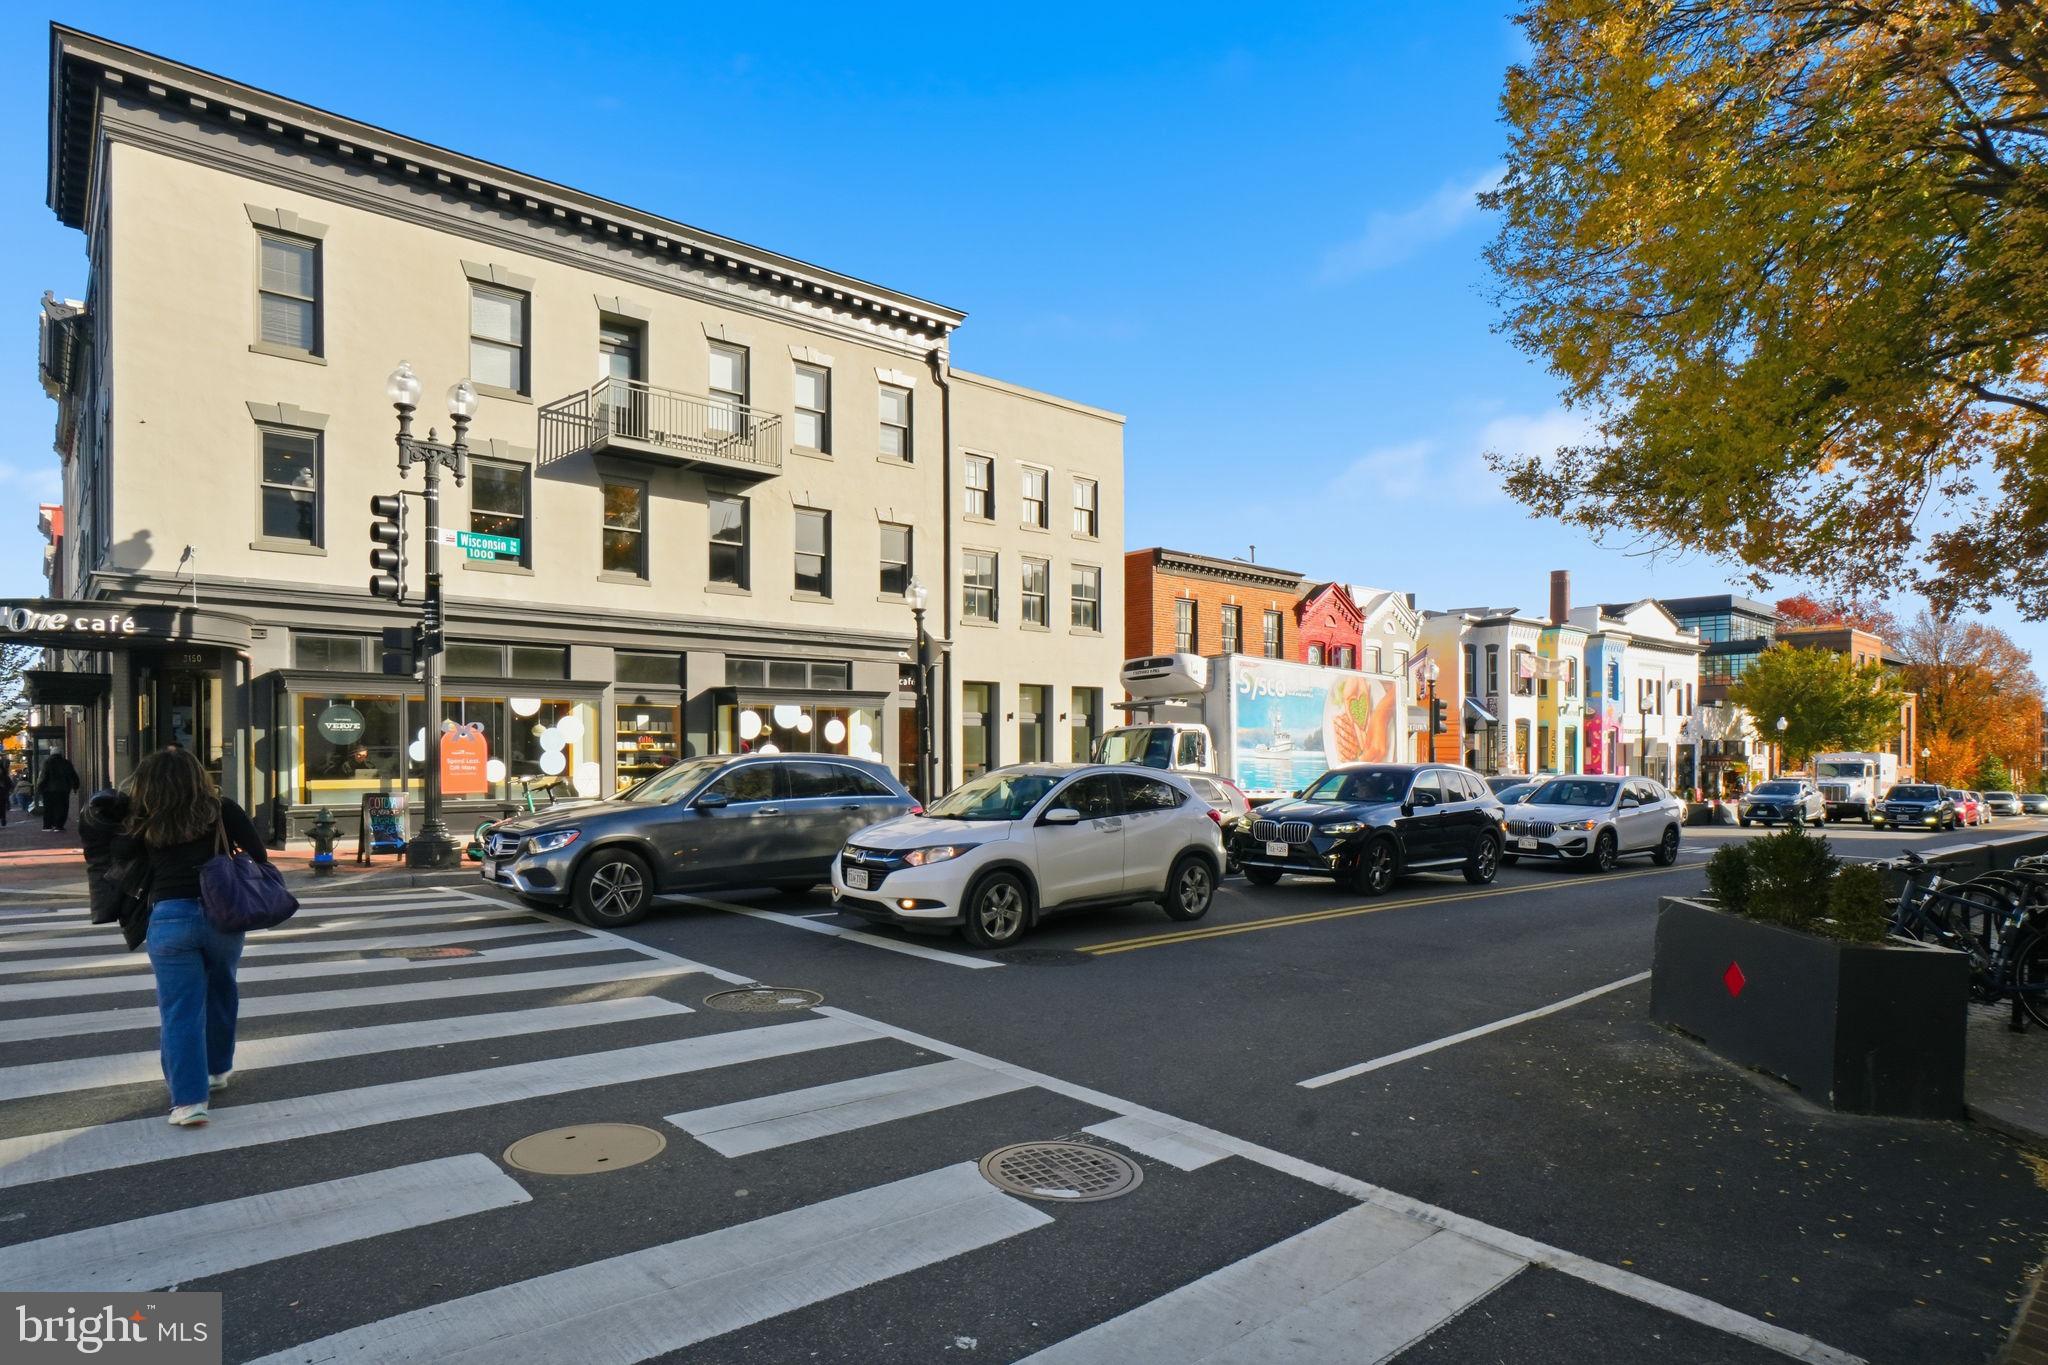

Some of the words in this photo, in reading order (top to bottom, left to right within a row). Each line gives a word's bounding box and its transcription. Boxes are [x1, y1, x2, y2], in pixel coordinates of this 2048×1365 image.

[460, 533, 507, 552] Wisconsin
[469, 548, 495, 559] 1000
[75, 615, 135, 633] café
[324, 722, 361, 730] VERVE
